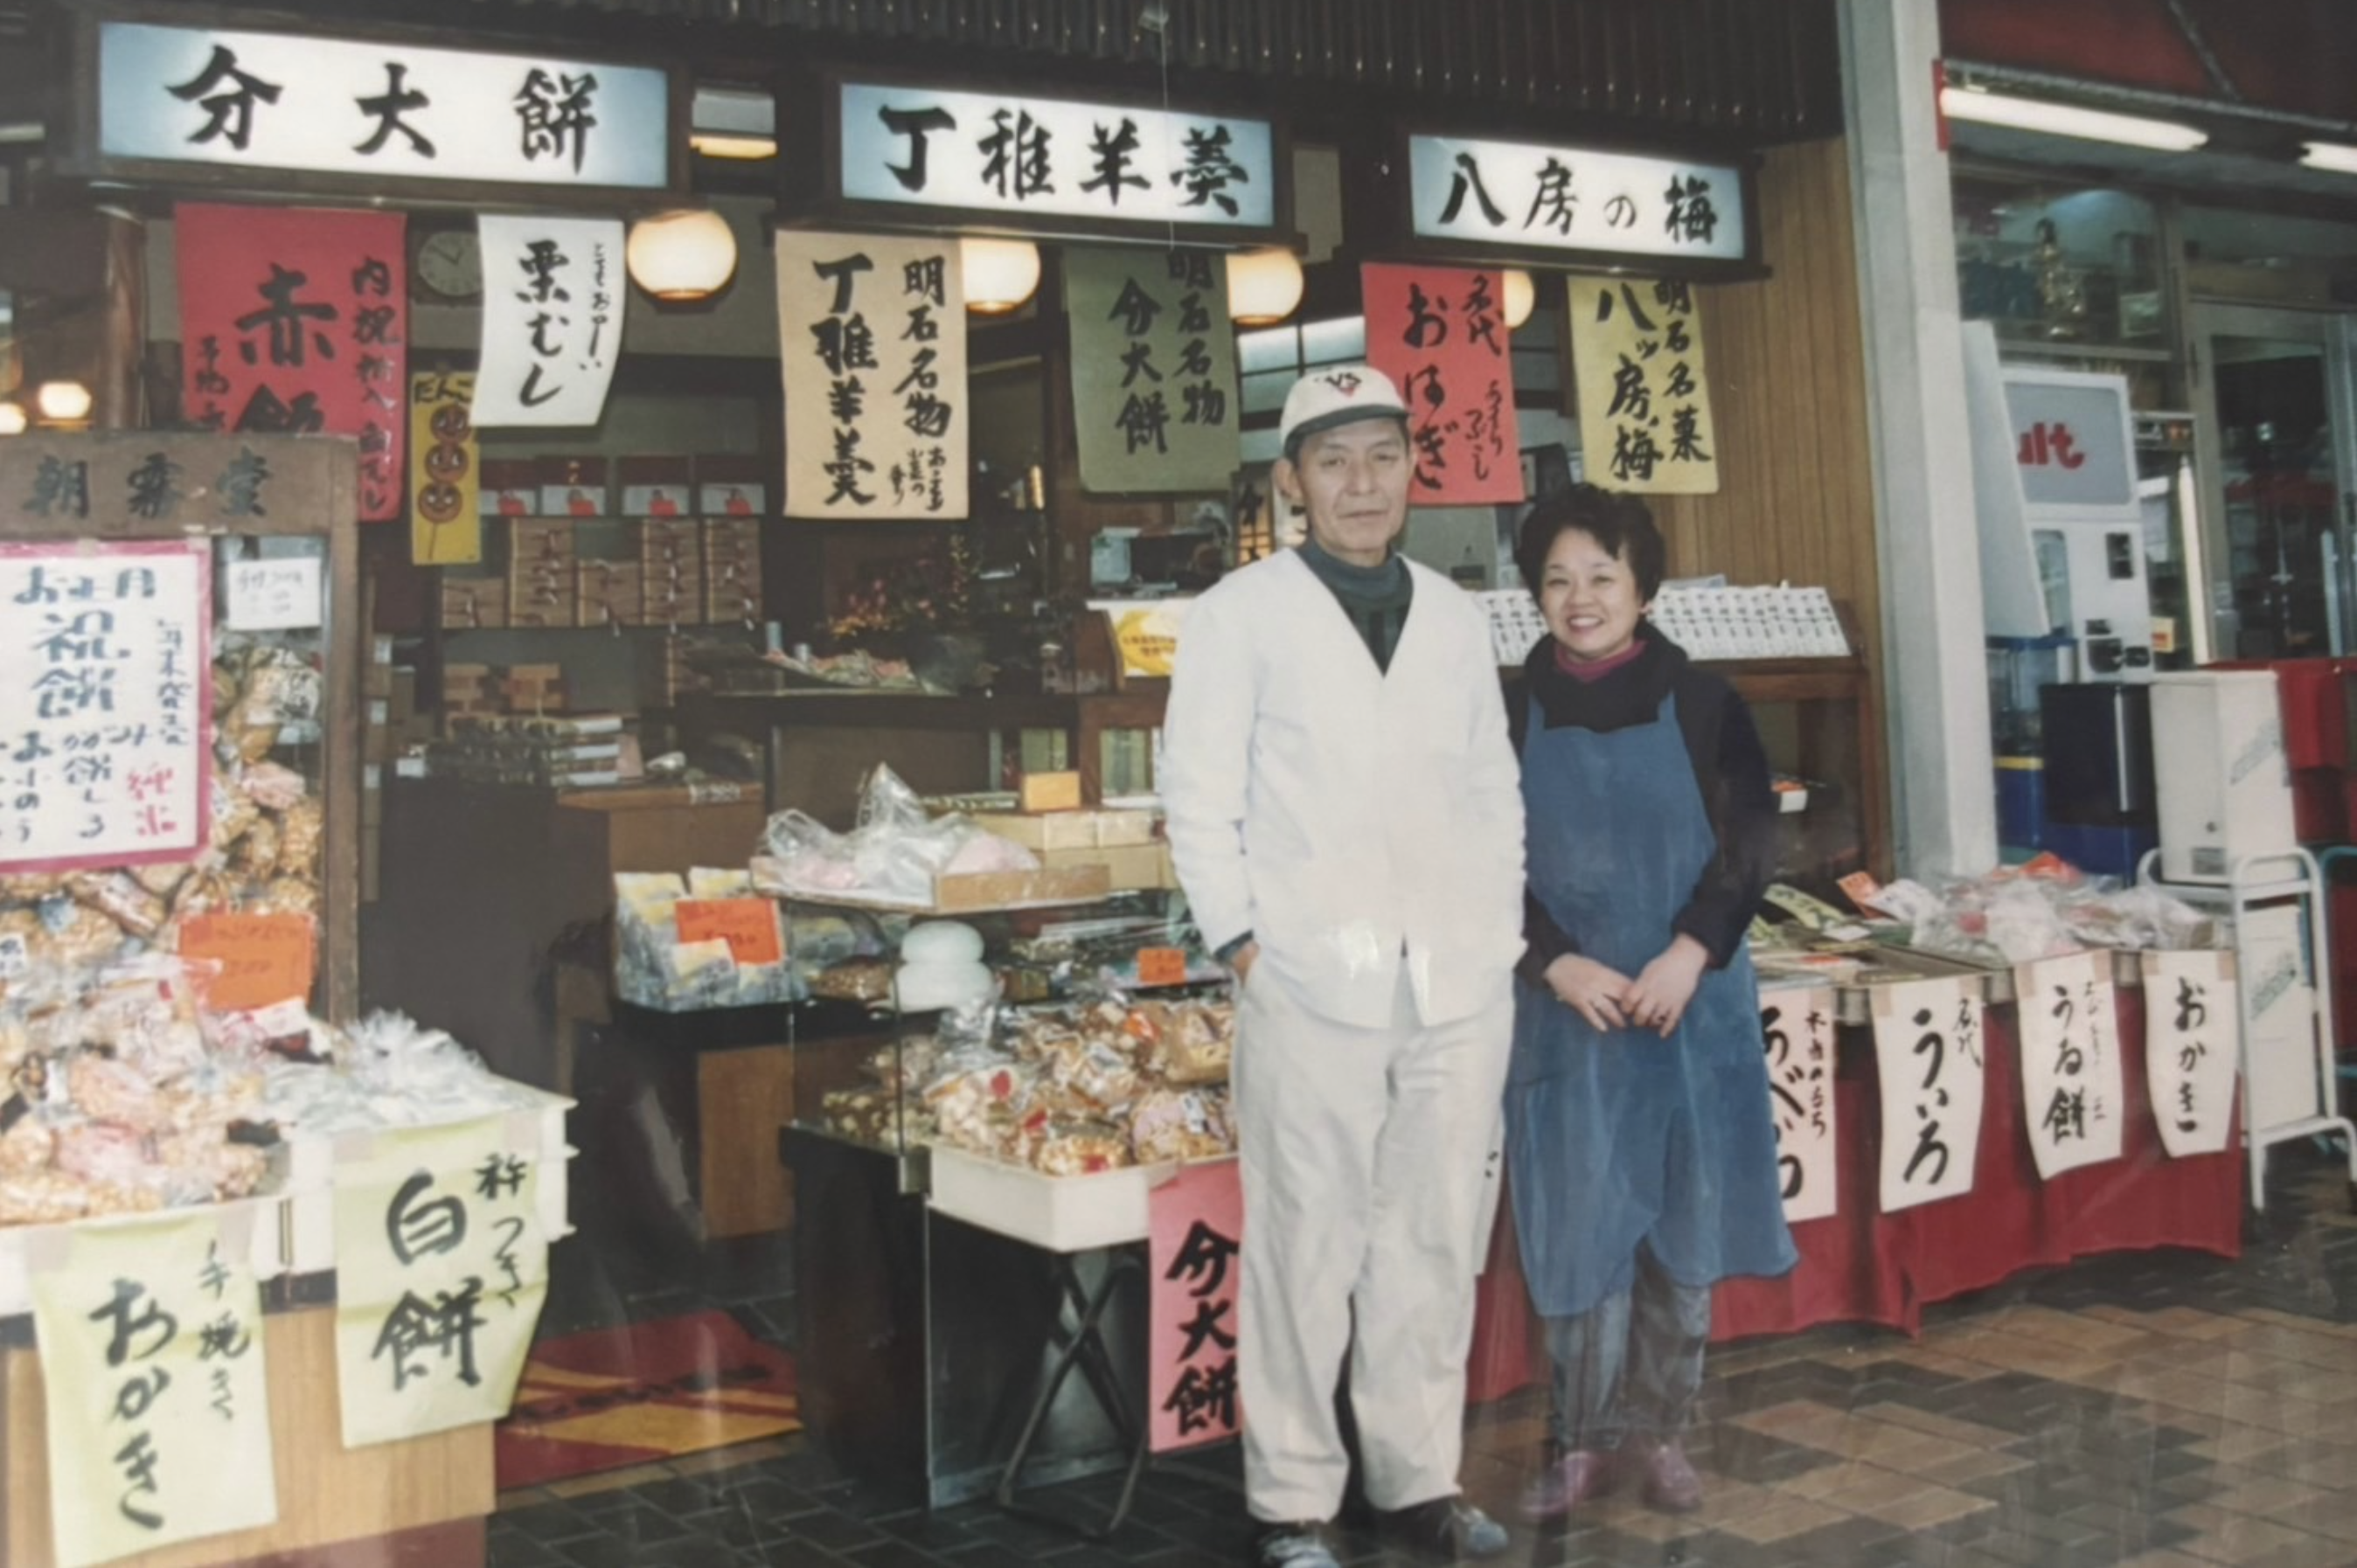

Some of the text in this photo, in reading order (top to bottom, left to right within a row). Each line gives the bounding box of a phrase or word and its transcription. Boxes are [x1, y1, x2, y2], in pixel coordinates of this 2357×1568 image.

[163, 44, 599, 176] 分大餅
[1439, 151, 1718, 245] 八房の梅
[515, 239, 571, 408] 栗むし
[893, 255, 951, 438] 明石名物
[1109, 277, 1172, 455] 分大餅
[1167, 248, 1225, 427] 明石名物
[1402, 281, 1459, 489] おはぎ
[1652, 276, 1713, 463] 明石名菓
[1903, 1009, 1950, 1184] ういろ
[2174, 977, 2208, 1134] おかき
[372, 1169, 488, 1391] 白餅
[1162, 1219, 1241, 1437] 分大餅
[89, 1277, 177, 1530] おかき
